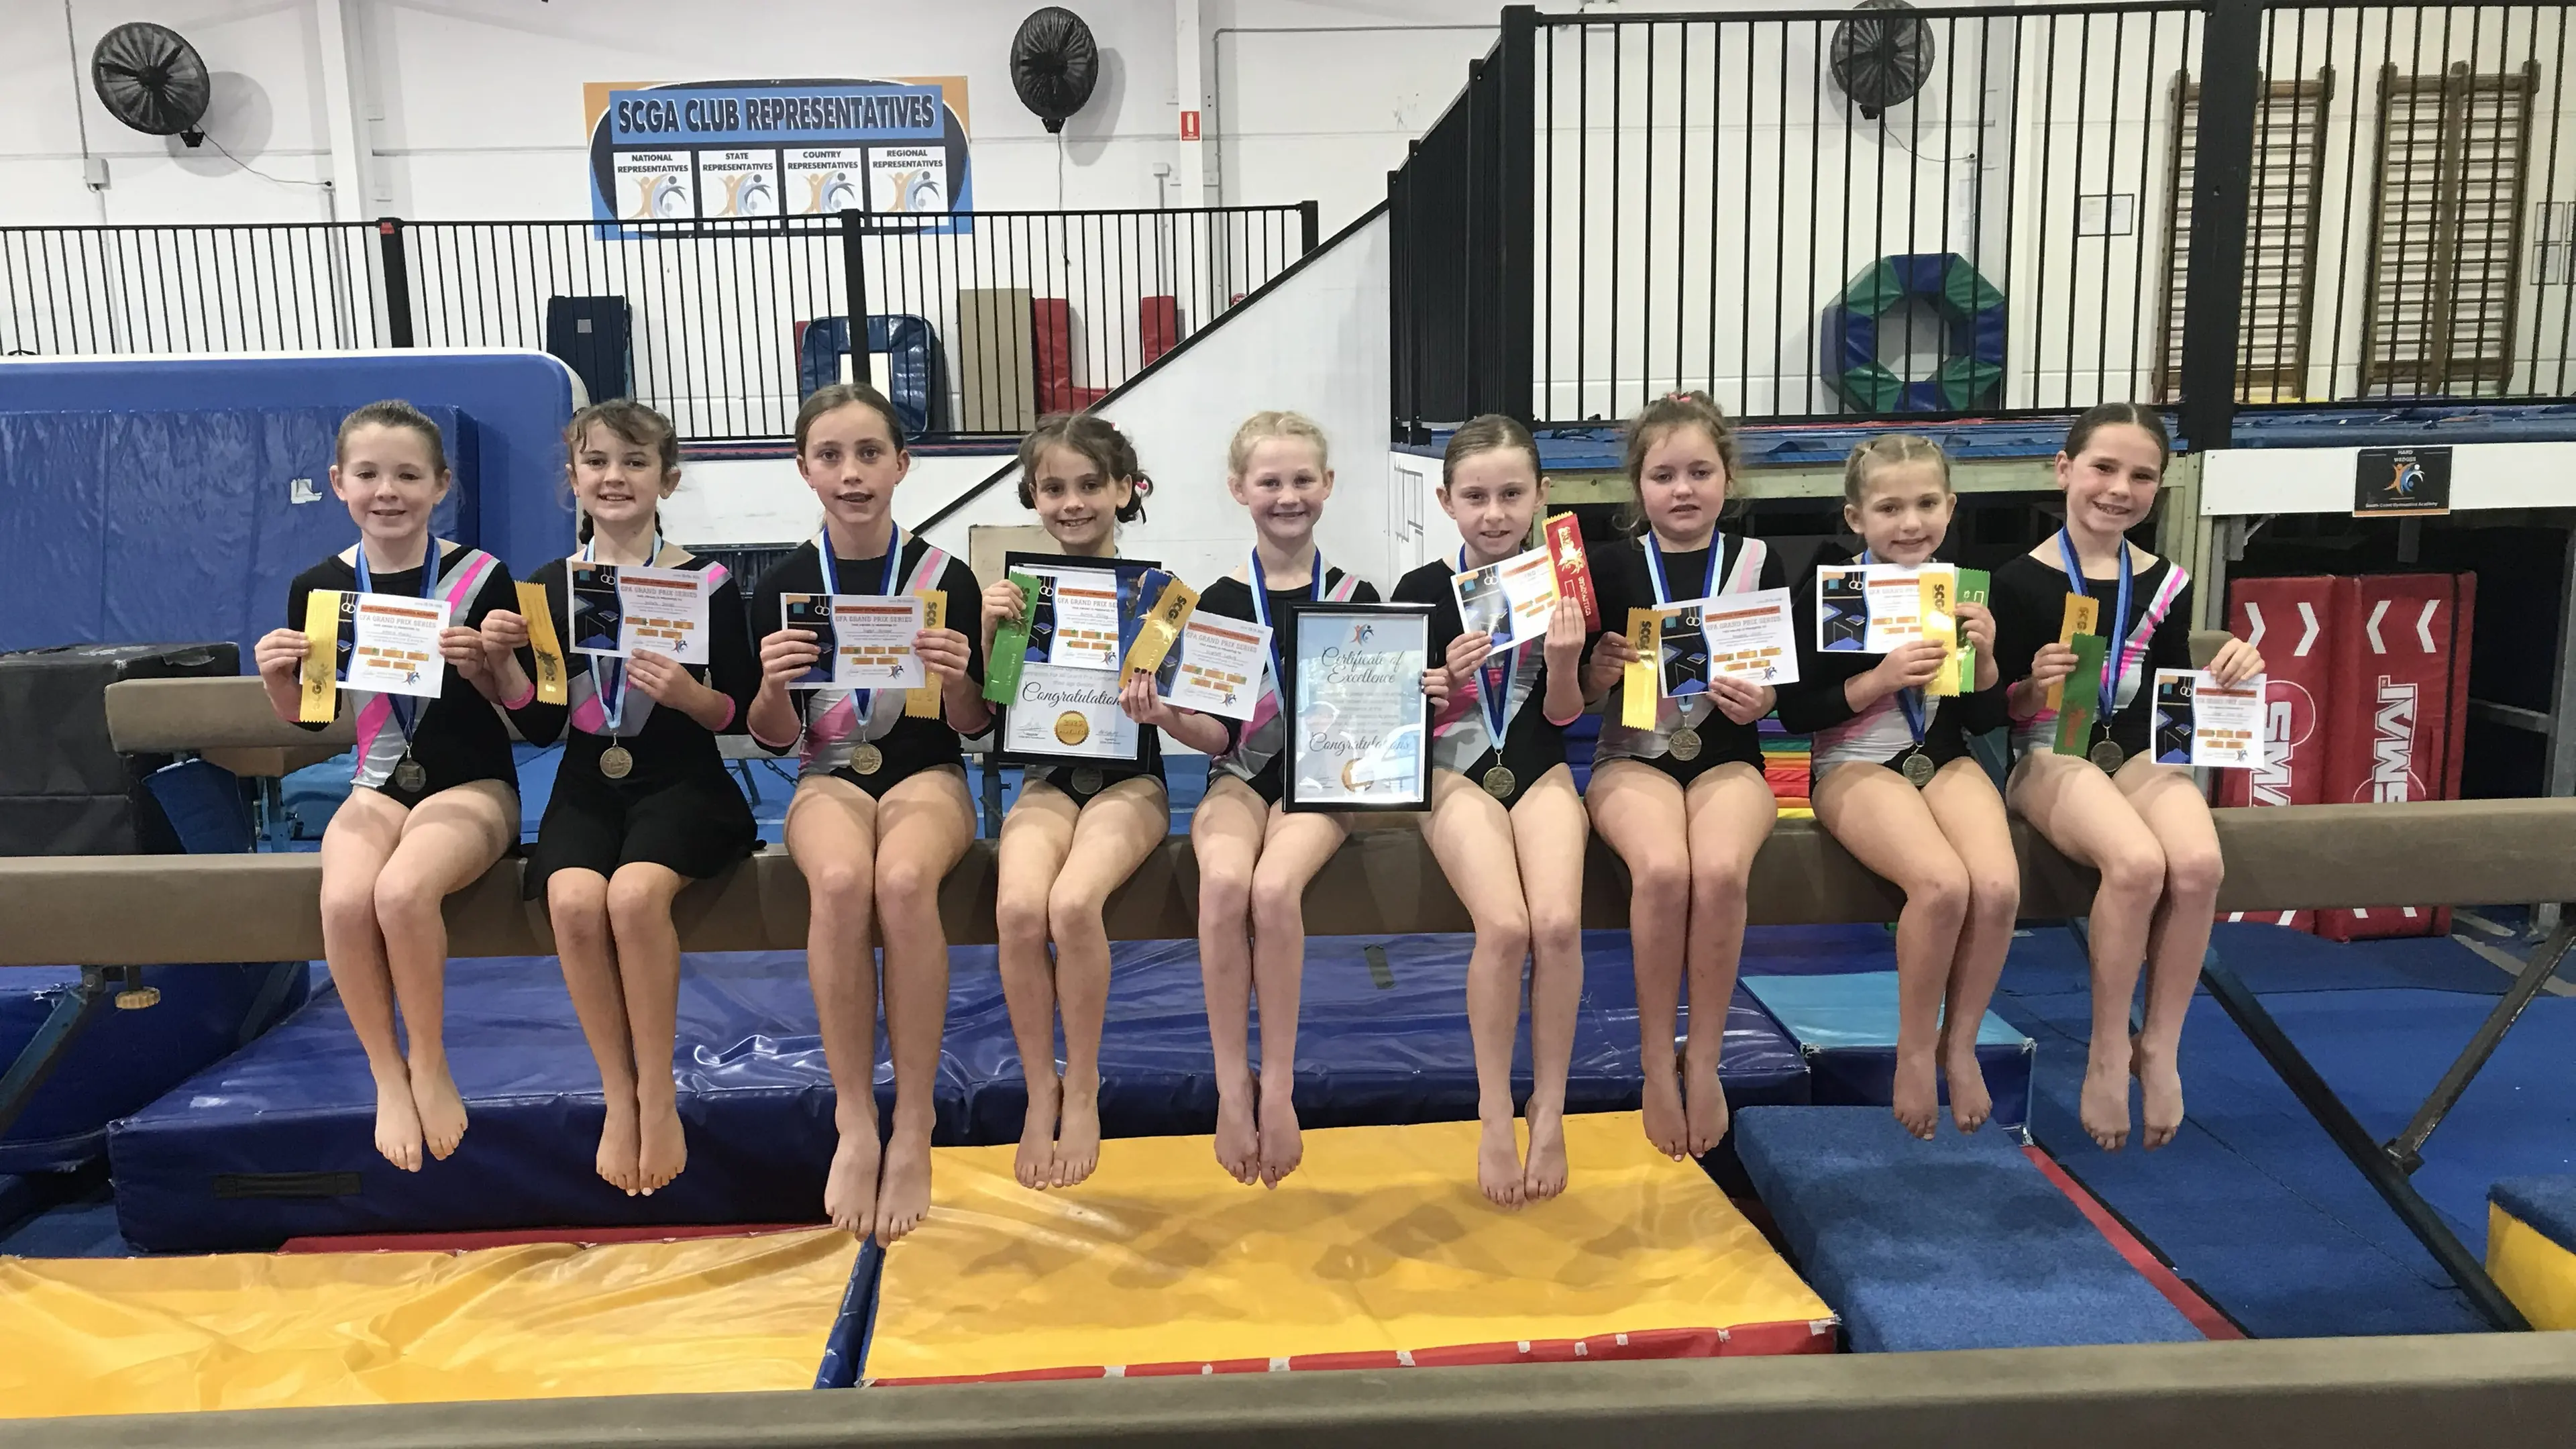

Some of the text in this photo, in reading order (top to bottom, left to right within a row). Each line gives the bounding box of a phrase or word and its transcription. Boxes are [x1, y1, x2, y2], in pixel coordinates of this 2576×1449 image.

[618, 95, 935, 133] SCGA CLUB REPRESENTATIVES
[632, 154, 673, 162] NATIONAL
[725, 152, 749, 160] STATE
[802, 150, 842, 159] COUNTRY
[887, 149, 928, 158] REGIONAL
[702, 162, 773, 172] REPRESENTATIVES
[788, 160, 859, 170] REPRESENTATIVES
[873, 158, 943, 168] REPRESENTATIVES
[617, 164, 689, 173] REPRESENTATIVES
[926, 601, 938, 627] SCG
[2077, 606, 2090, 631] SCG
[1322, 646, 1405, 672] Certificate of
[1327, 665, 1396, 684] Excellence
[1022, 681, 1121, 708] Congratulation
[1309, 731, 1410, 756] Congratulaons
